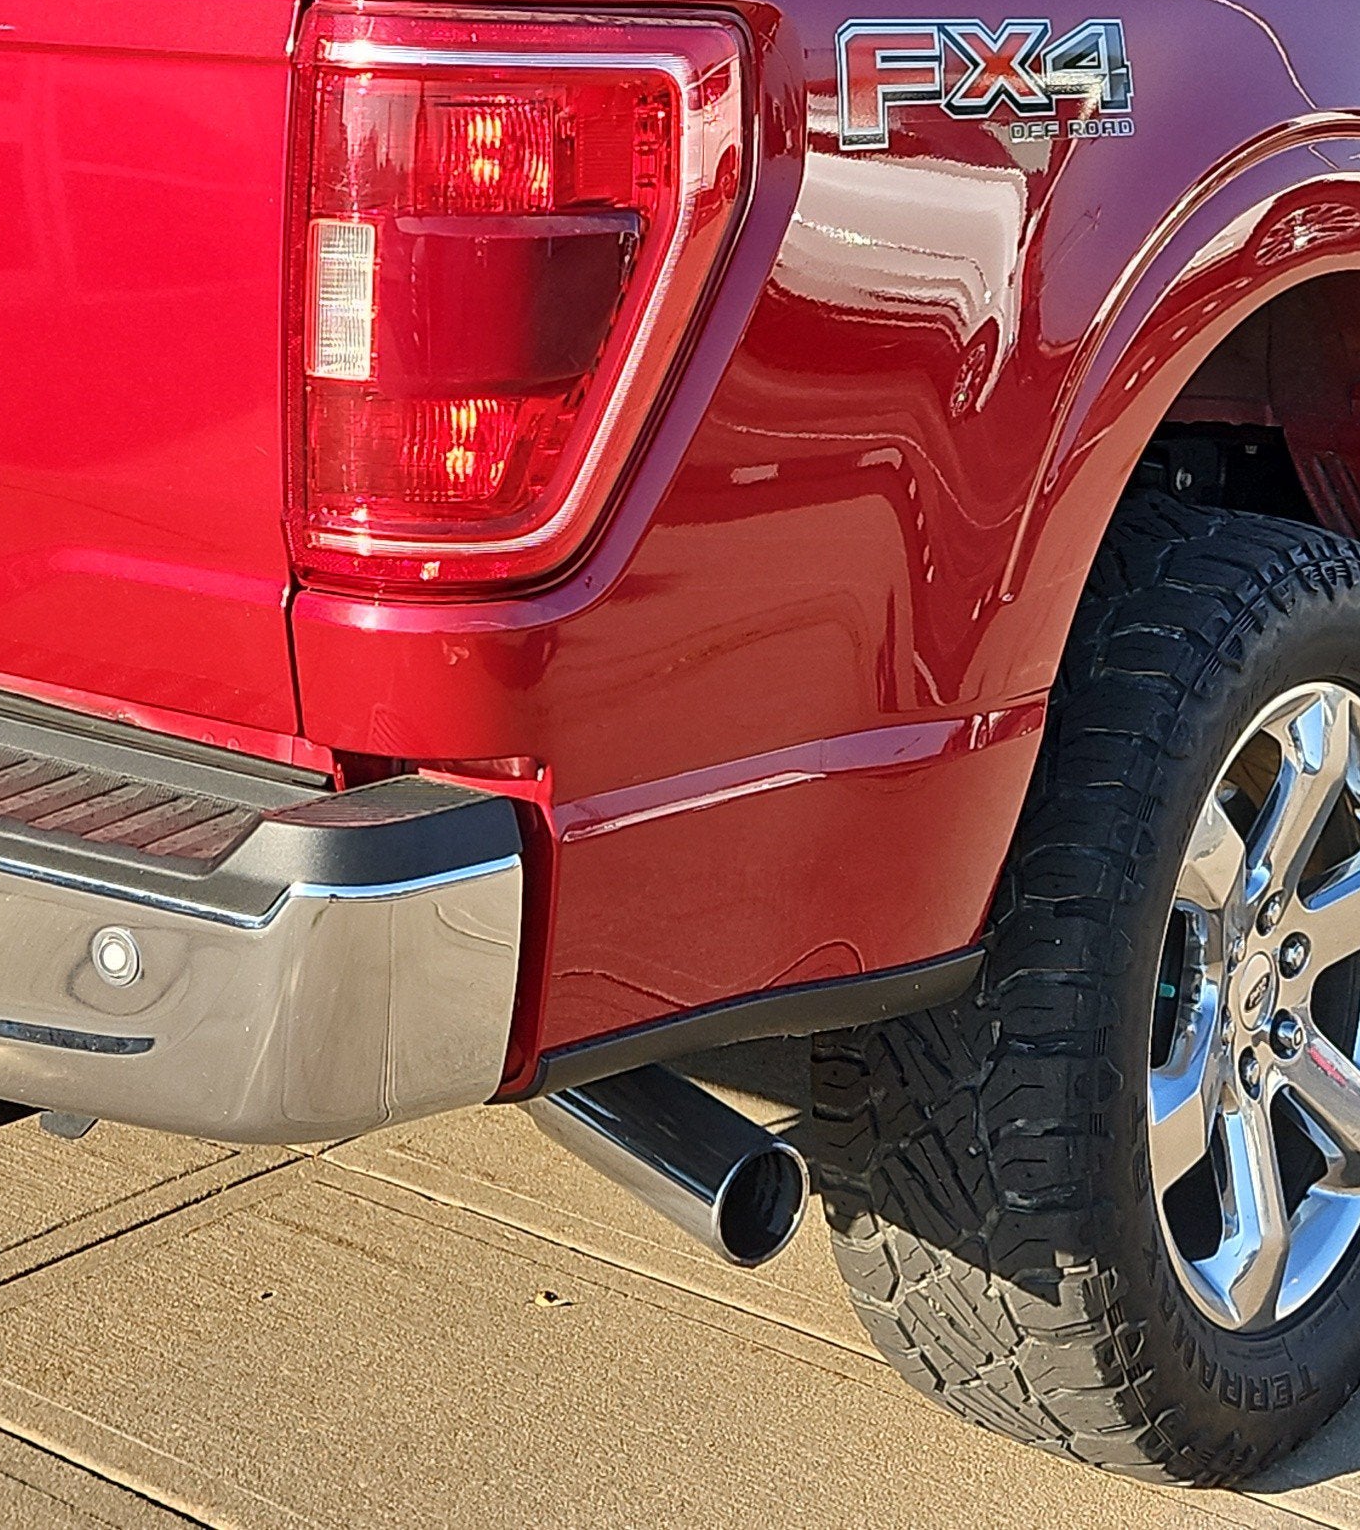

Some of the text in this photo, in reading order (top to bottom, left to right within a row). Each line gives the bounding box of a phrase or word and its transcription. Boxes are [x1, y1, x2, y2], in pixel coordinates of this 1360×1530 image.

[835, 18, 1134, 150] FX4
[1010, 118, 1135, 140] OFF ROAD
